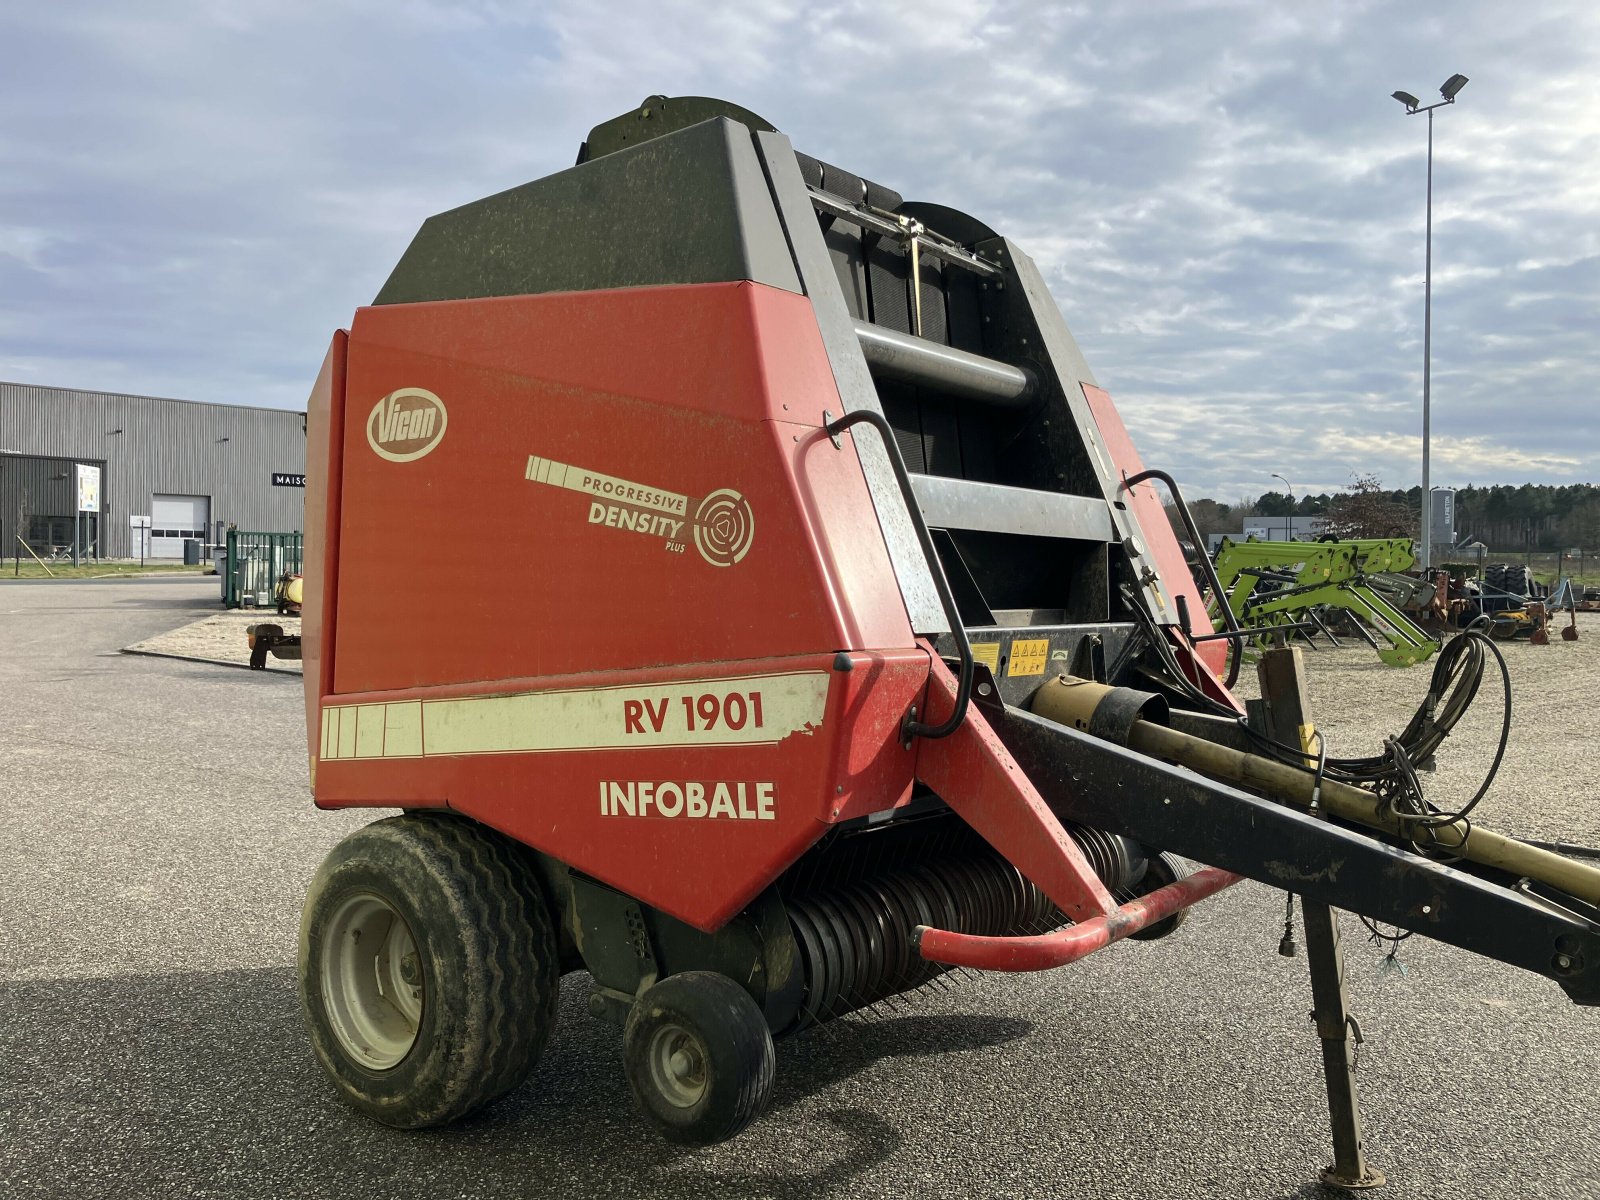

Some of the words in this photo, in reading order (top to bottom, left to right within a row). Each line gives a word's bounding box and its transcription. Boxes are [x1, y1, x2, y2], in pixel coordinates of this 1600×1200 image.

[378, 394, 437, 443] Vicon
[582, 476, 684, 511] PROGRESSIVE
[588, 502, 685, 539] DENSITY
[665, 541, 686, 553] PLUS
[624, 698, 670, 734] RV
[681, 691, 764, 732] 1901
[600, 781, 776, 820] INFOBALE
